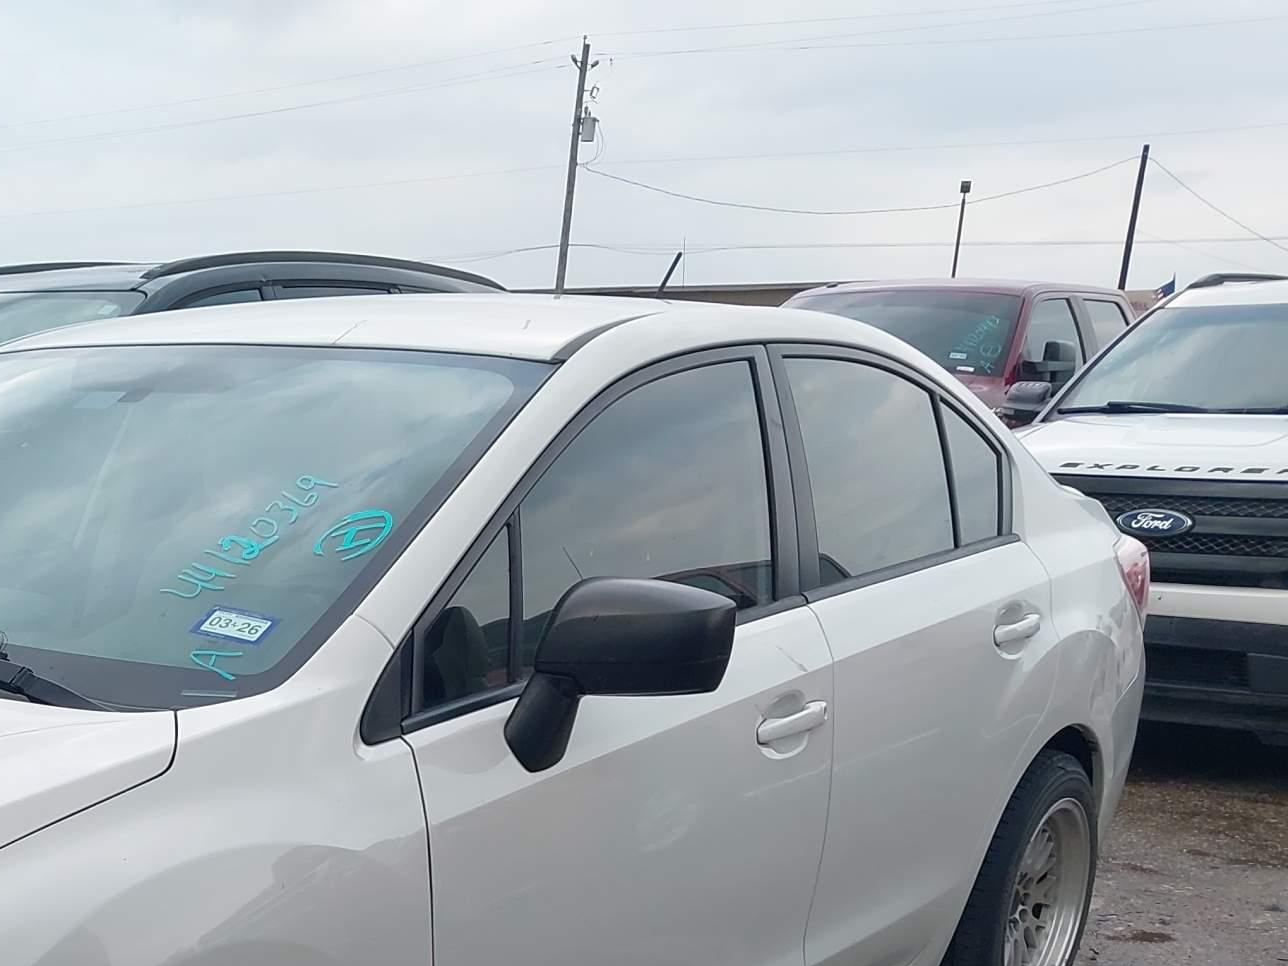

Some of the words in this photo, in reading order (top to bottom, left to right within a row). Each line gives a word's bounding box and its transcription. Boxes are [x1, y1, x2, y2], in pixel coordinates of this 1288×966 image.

[159, 475, 339, 598] 44120369
[1131, 512, 1175, 530] Ford
[190, 650, 243, 681] A
